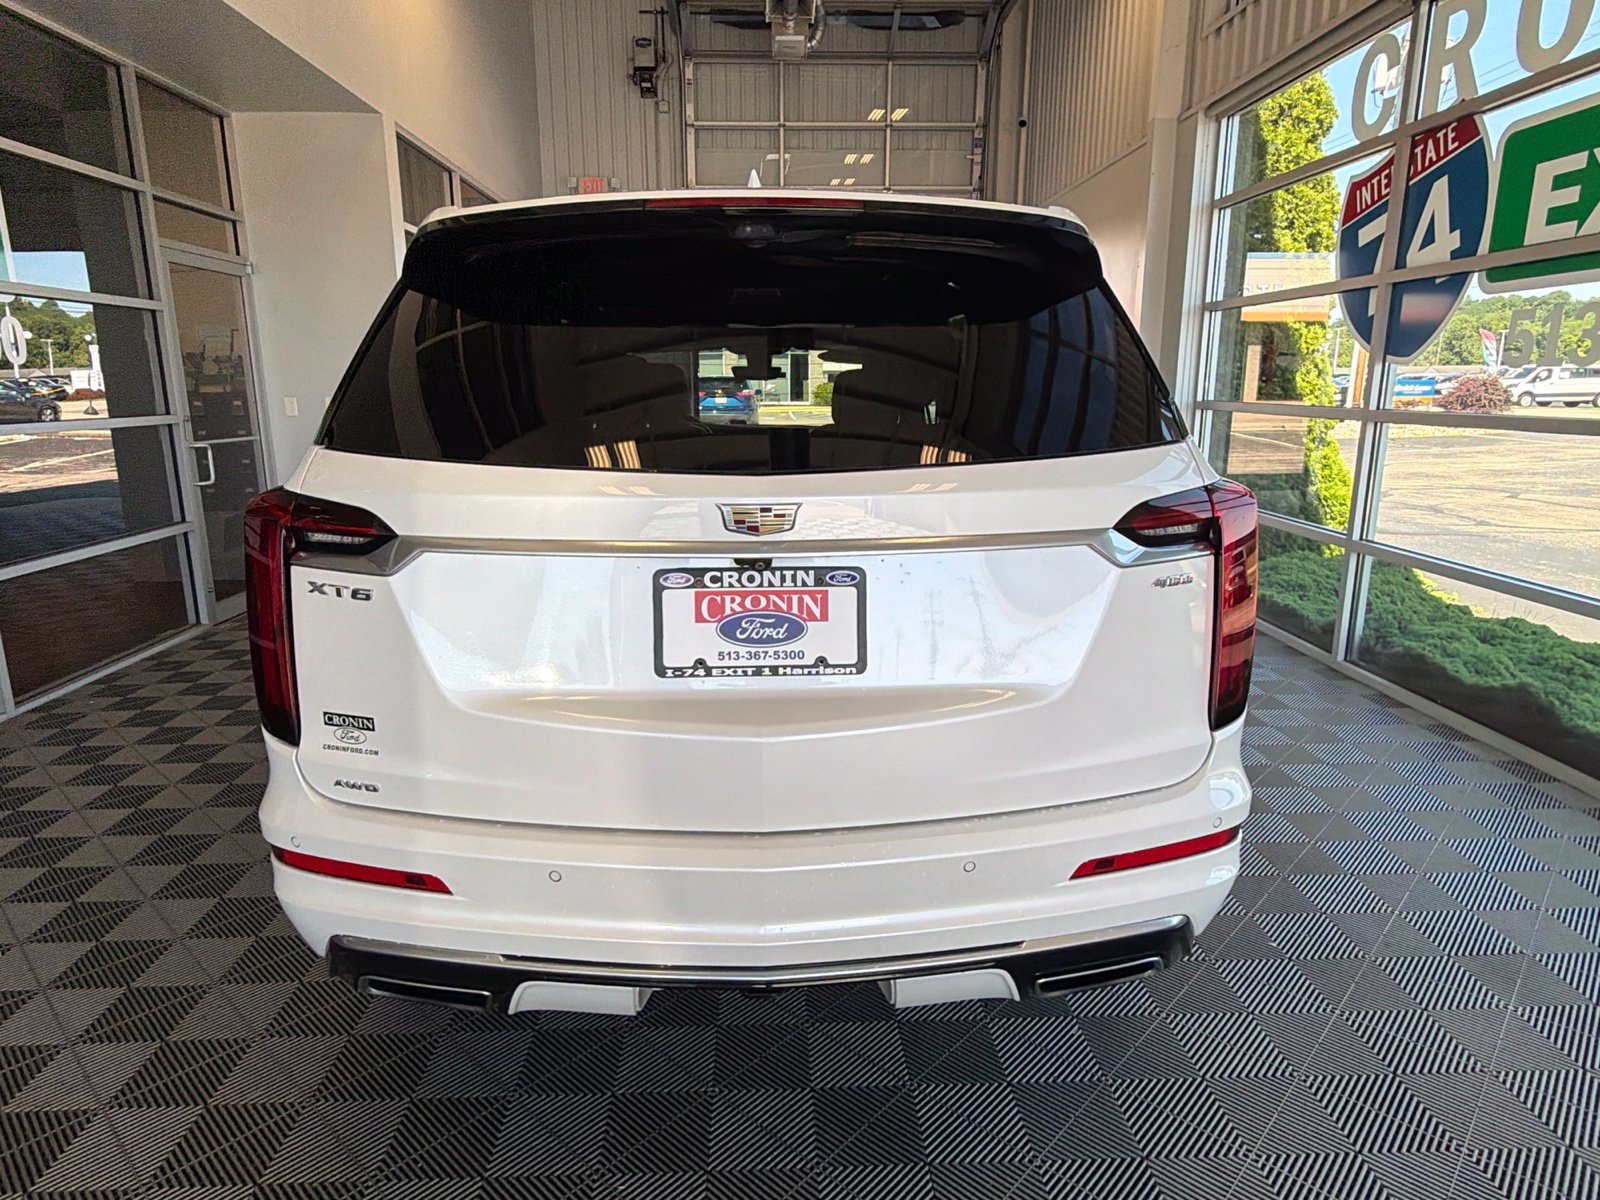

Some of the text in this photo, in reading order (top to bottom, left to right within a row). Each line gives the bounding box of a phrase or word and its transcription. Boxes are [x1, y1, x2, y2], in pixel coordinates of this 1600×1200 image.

[1356, 121, 1460, 214] INTETATE
[703, 570, 815, 588] CRONIN
[307, 581, 373, 601] XT6
[701, 594, 823, 621] CRONIN
[736, 617, 789, 639] Ford
[717, 650, 805, 661] 513-367-5300
[665, 666, 857, 677] I-74 EXIT 1 Harrison
[324, 714, 374, 730] CRONIN
[340, 729, 361, 742] Ford
[322, 743, 379, 756] CRONINFORD.COM
[333, 779, 380, 793] AWD
